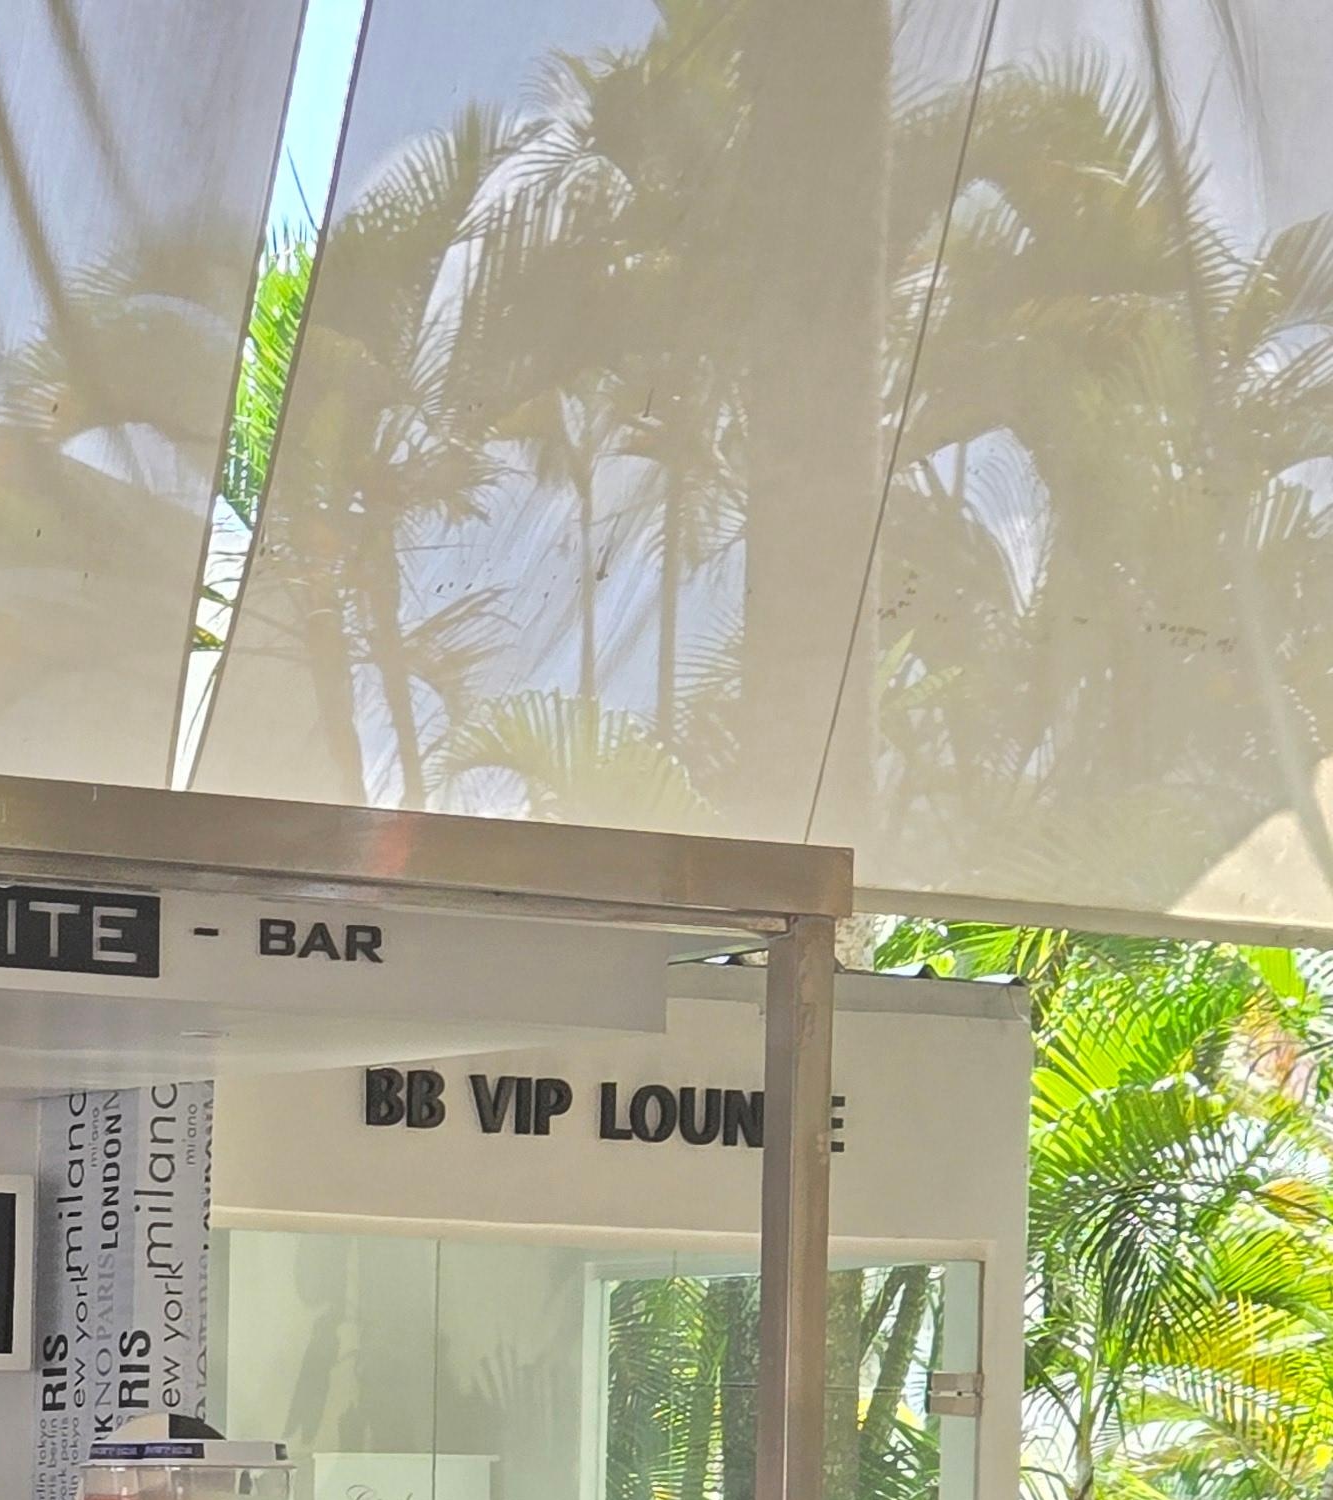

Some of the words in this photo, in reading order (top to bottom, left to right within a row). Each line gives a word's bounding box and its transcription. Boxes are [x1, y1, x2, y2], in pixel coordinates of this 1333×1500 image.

[259, 917, 384, 963] BAR
[365, 1067, 446, 1129] BB
[468, 1073, 573, 1136] VIP
[599, 1081, 846, 1153] LOUNE
[101, 1114, 123, 1250] LONDON
[42, 1334, 69, 1411] RIS
[118, 1330, 152, 1409] RIS
